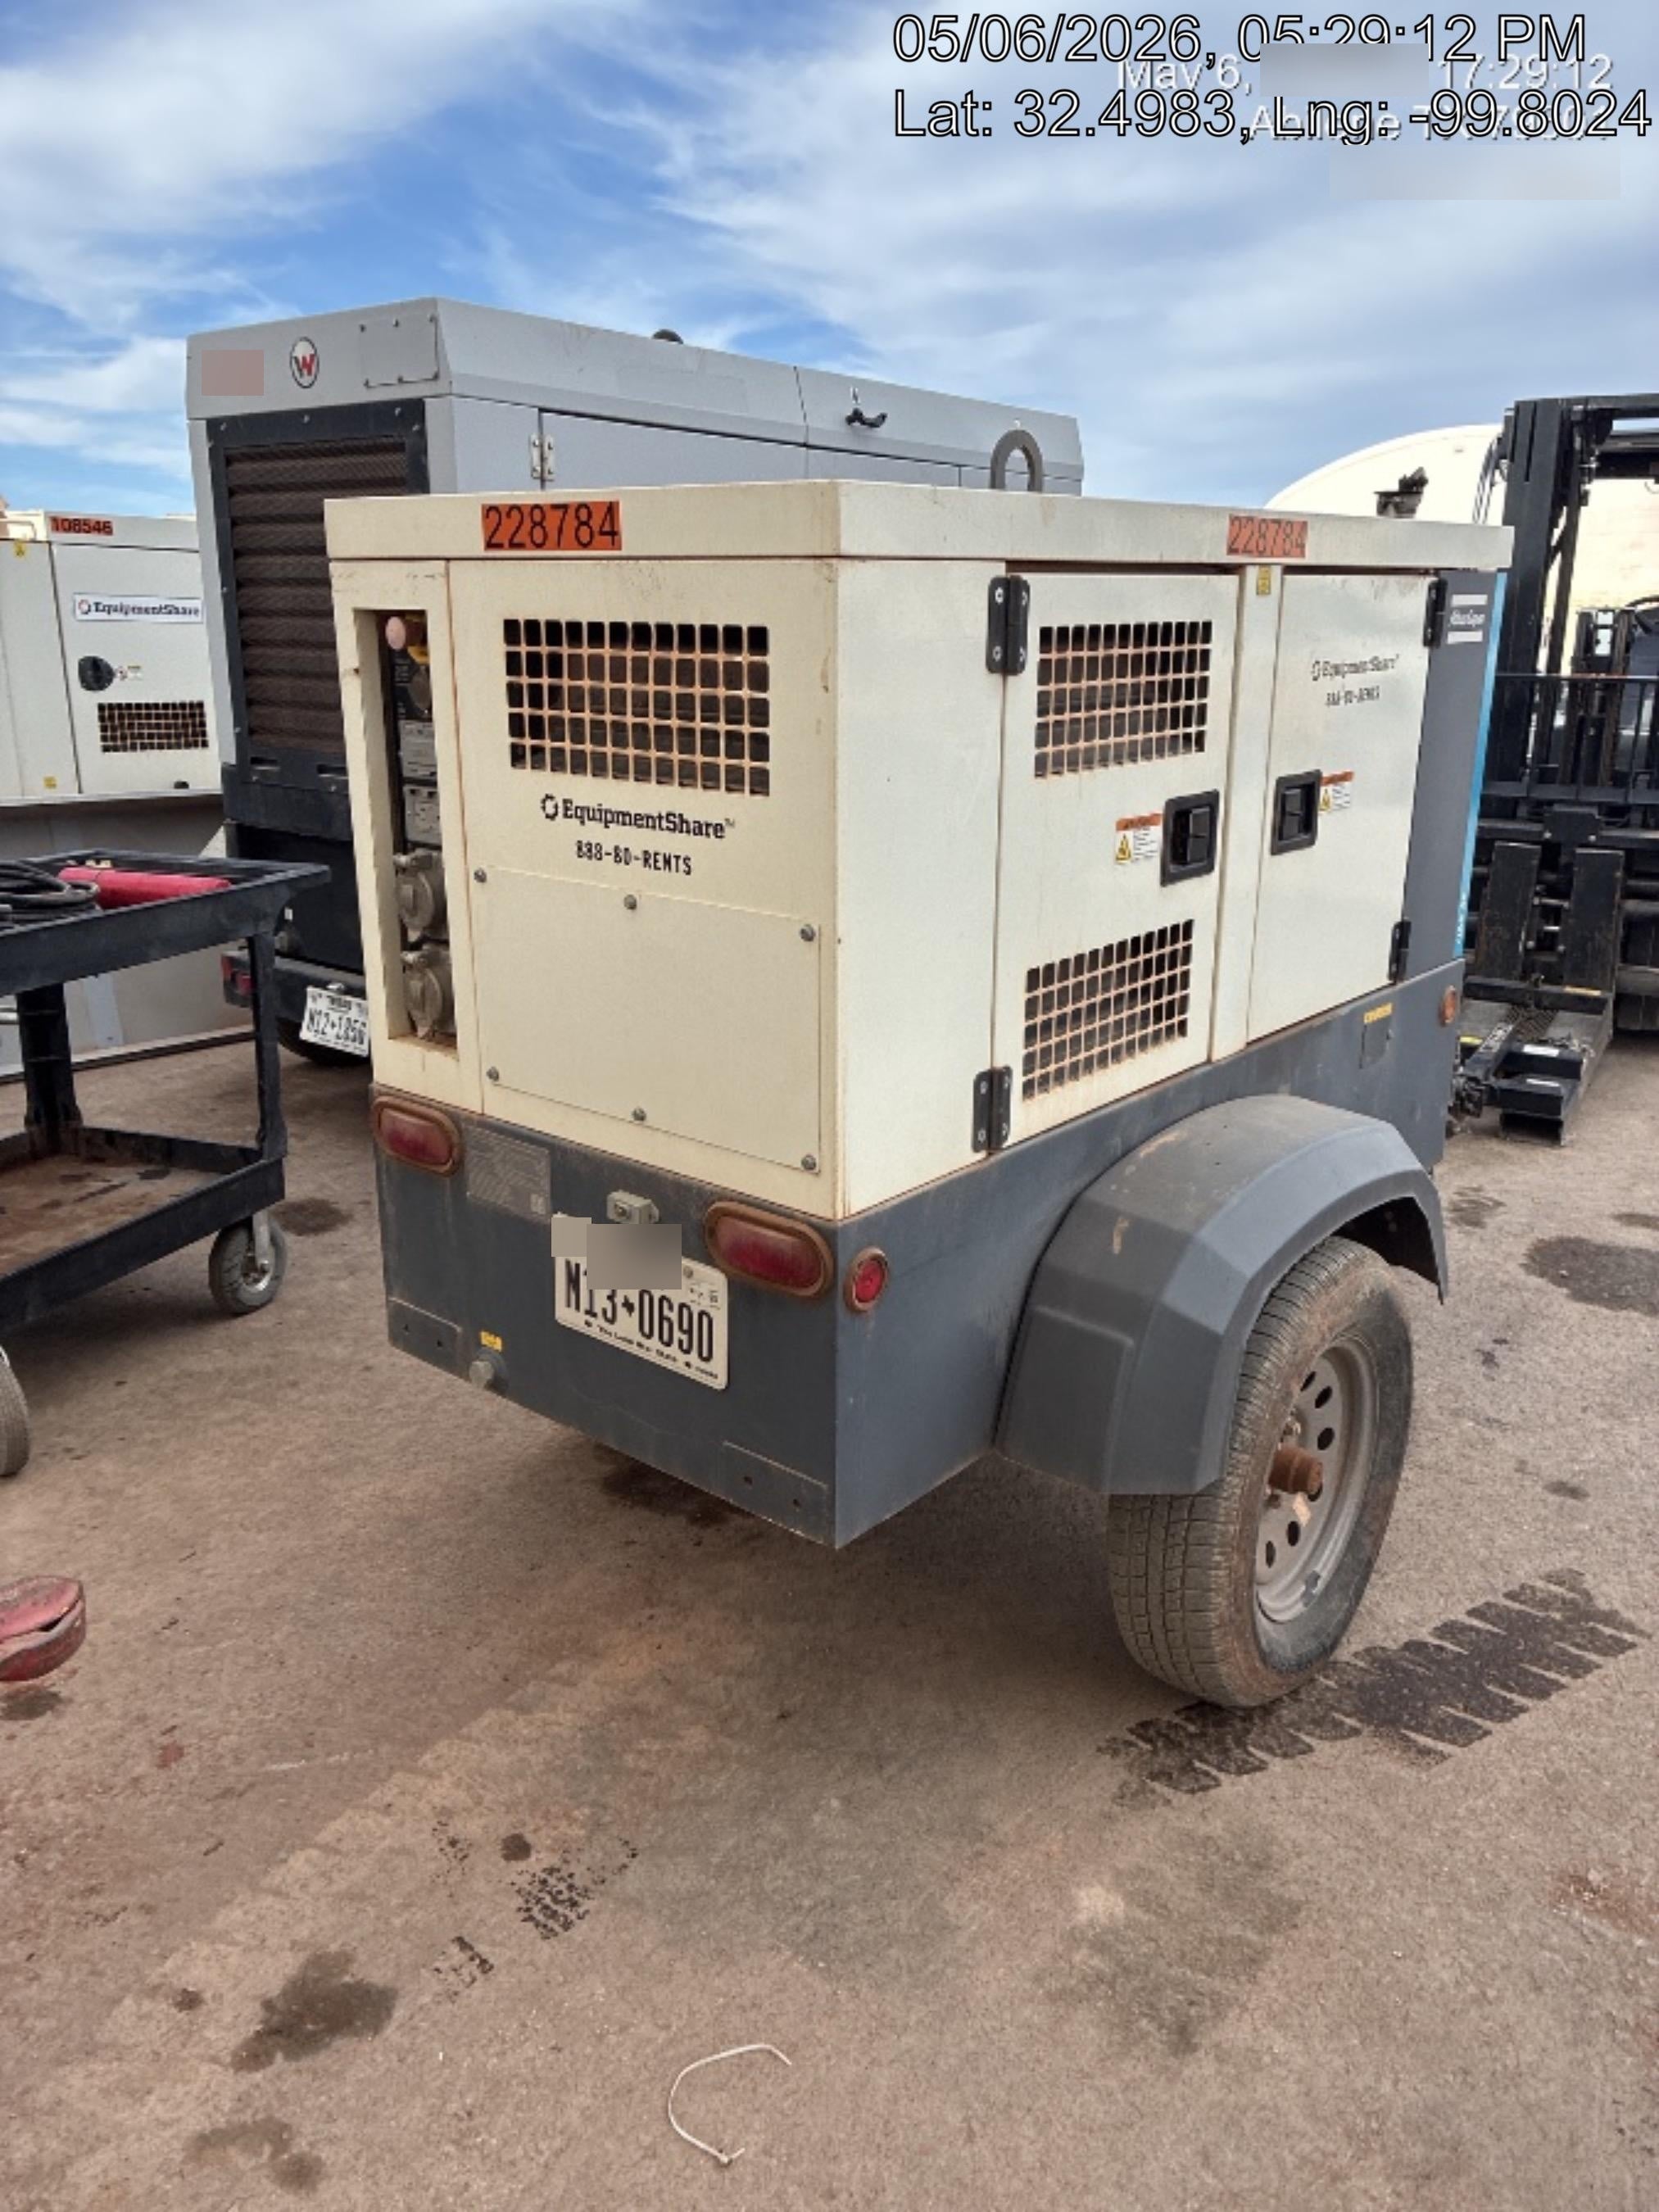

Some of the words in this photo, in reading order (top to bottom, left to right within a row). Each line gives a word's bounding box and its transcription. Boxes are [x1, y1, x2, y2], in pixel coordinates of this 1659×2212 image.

[52, 517, 113, 535] 108546
[484, 501, 619, 549] 228784
[562, 798, 726, 840] EquipmentShare
